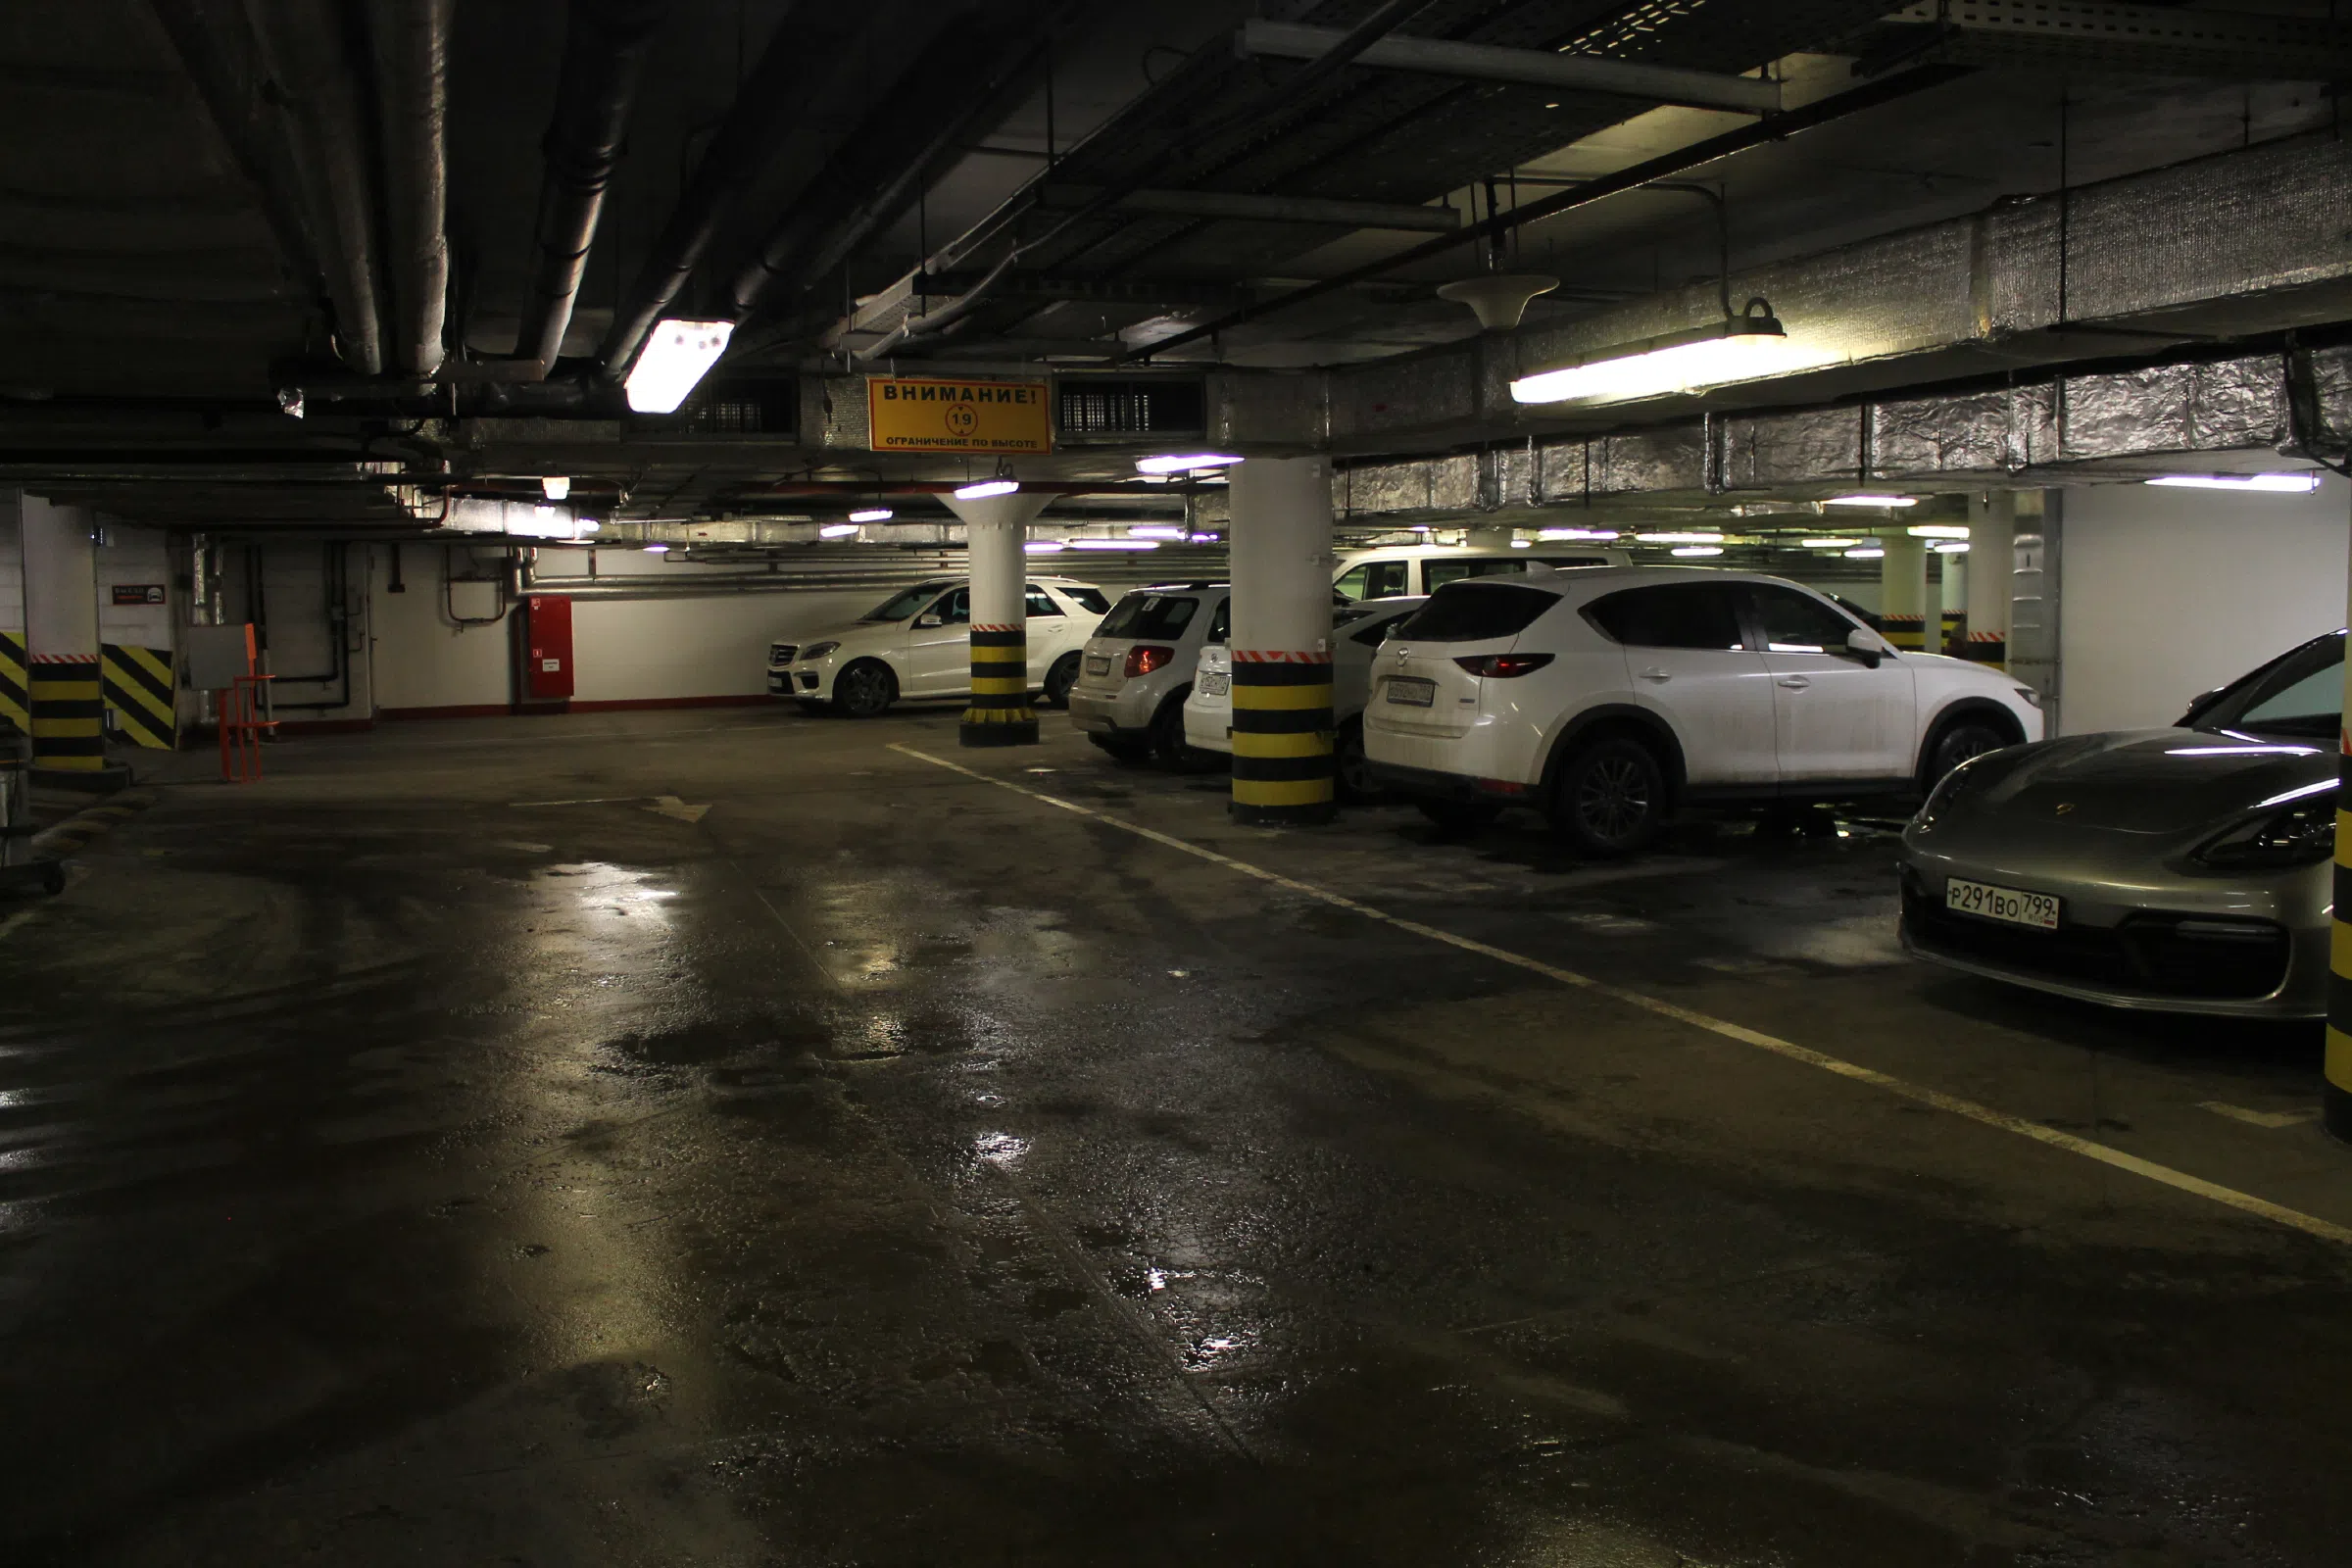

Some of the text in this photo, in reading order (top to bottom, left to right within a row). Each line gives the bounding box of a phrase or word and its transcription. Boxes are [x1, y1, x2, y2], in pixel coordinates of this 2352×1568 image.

[884, 385, 1037, 404] ВНИМАНИЕ!
[886, 436, 969, 447] ОГРАНИЧЕНИЕ
[992, 439, 1038, 449] ВЫСОТЕ
[2023, 894, 2053, 917] 799
[2028, 913, 2044, 923] RUS
